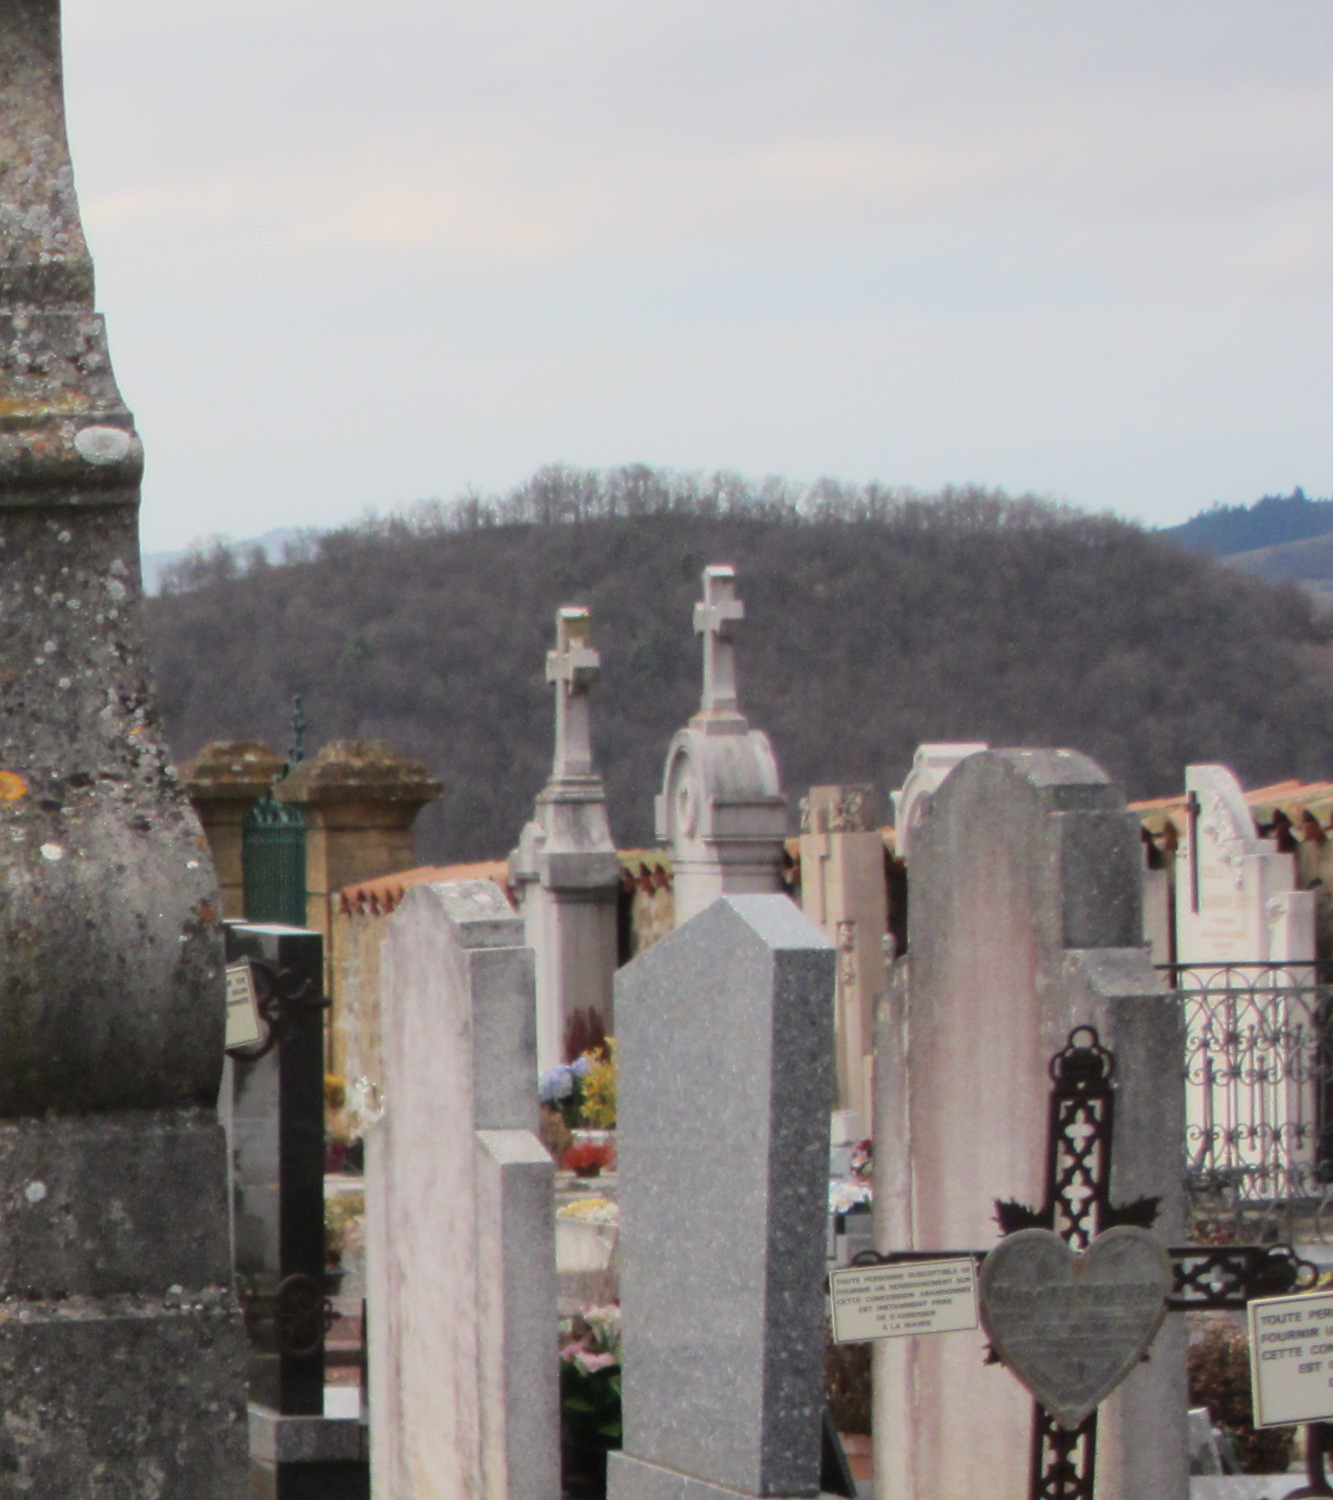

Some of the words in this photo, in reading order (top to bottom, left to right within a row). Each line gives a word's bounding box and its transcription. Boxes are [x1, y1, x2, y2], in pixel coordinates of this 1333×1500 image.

[1261, 1312, 1301, 1325] TOUTE
[1261, 1328, 1319, 1343] FOURNIR
[1262, 1347, 1302, 1360] CETTE
[1299, 1362, 1321, 1373] EST
